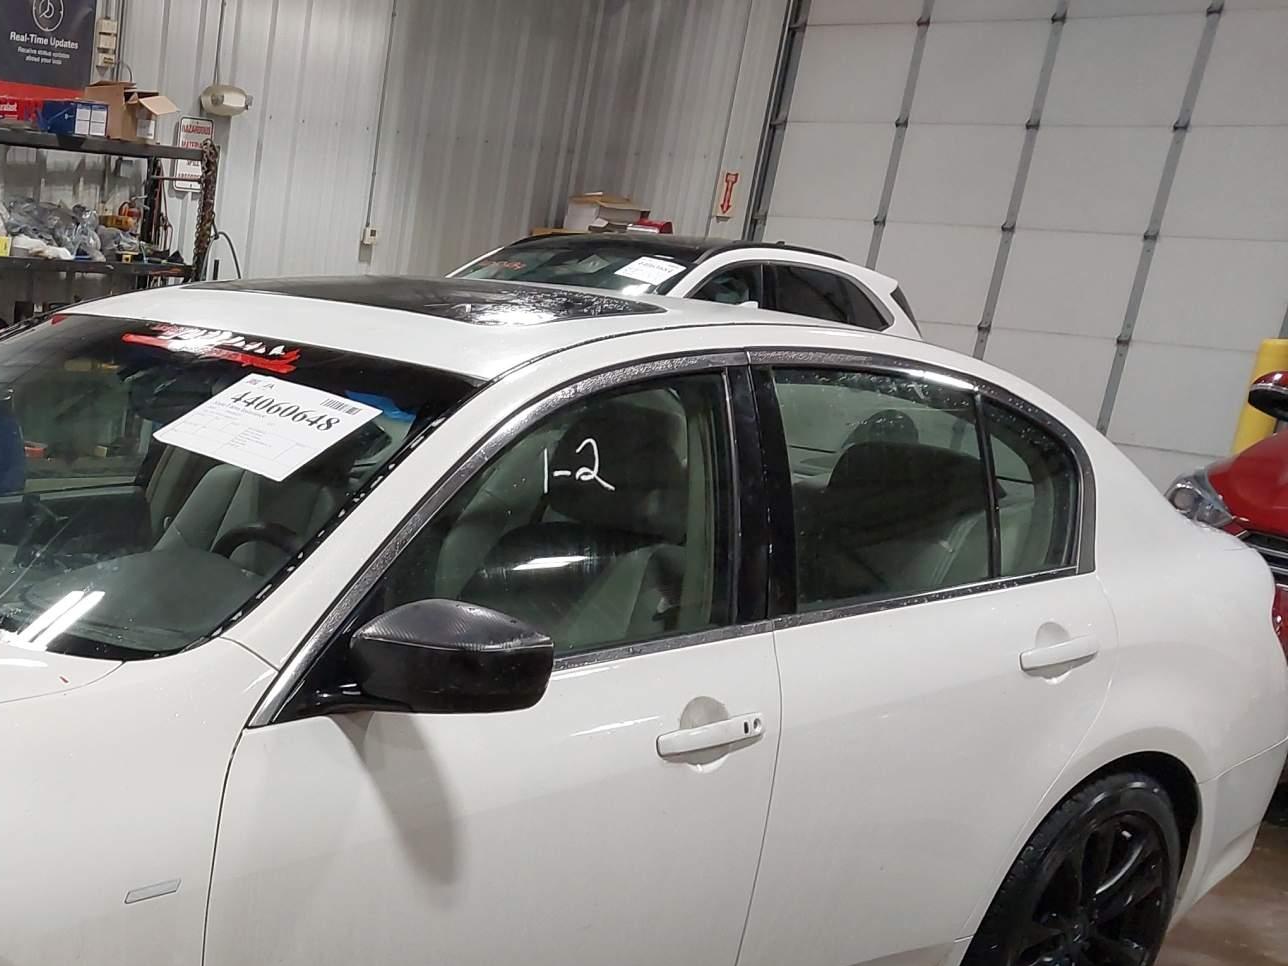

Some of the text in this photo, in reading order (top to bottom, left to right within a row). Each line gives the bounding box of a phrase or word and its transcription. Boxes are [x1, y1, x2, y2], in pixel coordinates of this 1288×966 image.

[10, 31, 78, 49] Real-Time Updates
[230, 391, 340, 431] 44060648
